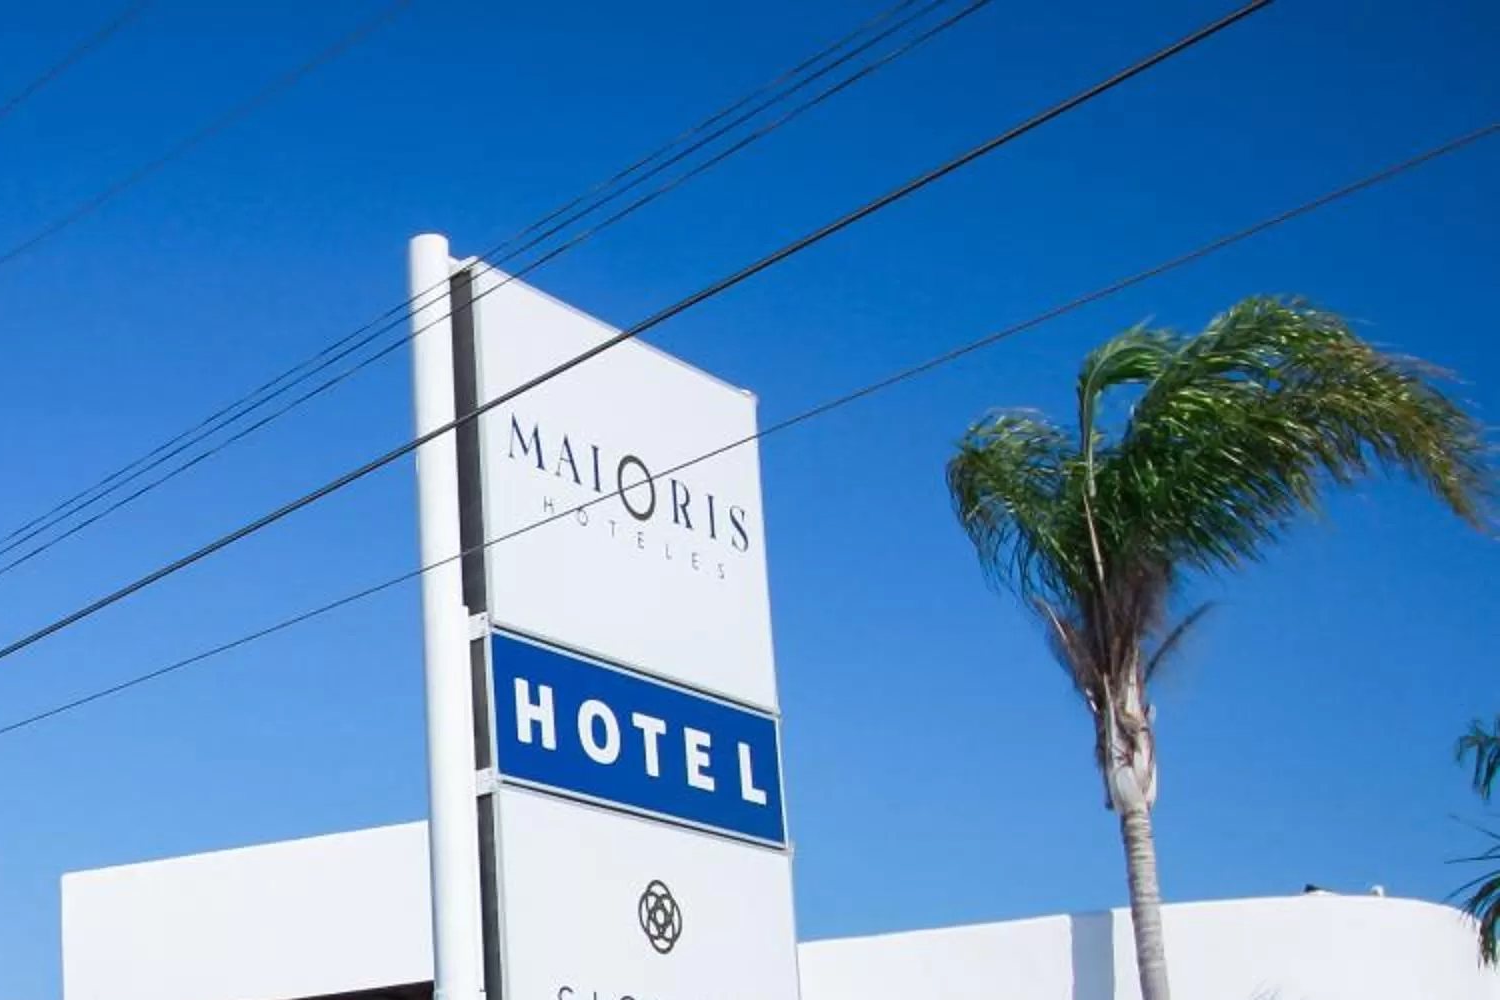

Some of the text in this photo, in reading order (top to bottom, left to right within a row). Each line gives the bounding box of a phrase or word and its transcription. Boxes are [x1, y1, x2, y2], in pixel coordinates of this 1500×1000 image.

[508, 413, 749, 553] MAIORIS
[543, 496, 725, 580] HOTELES
[514, 678, 768, 805] HOTEL
